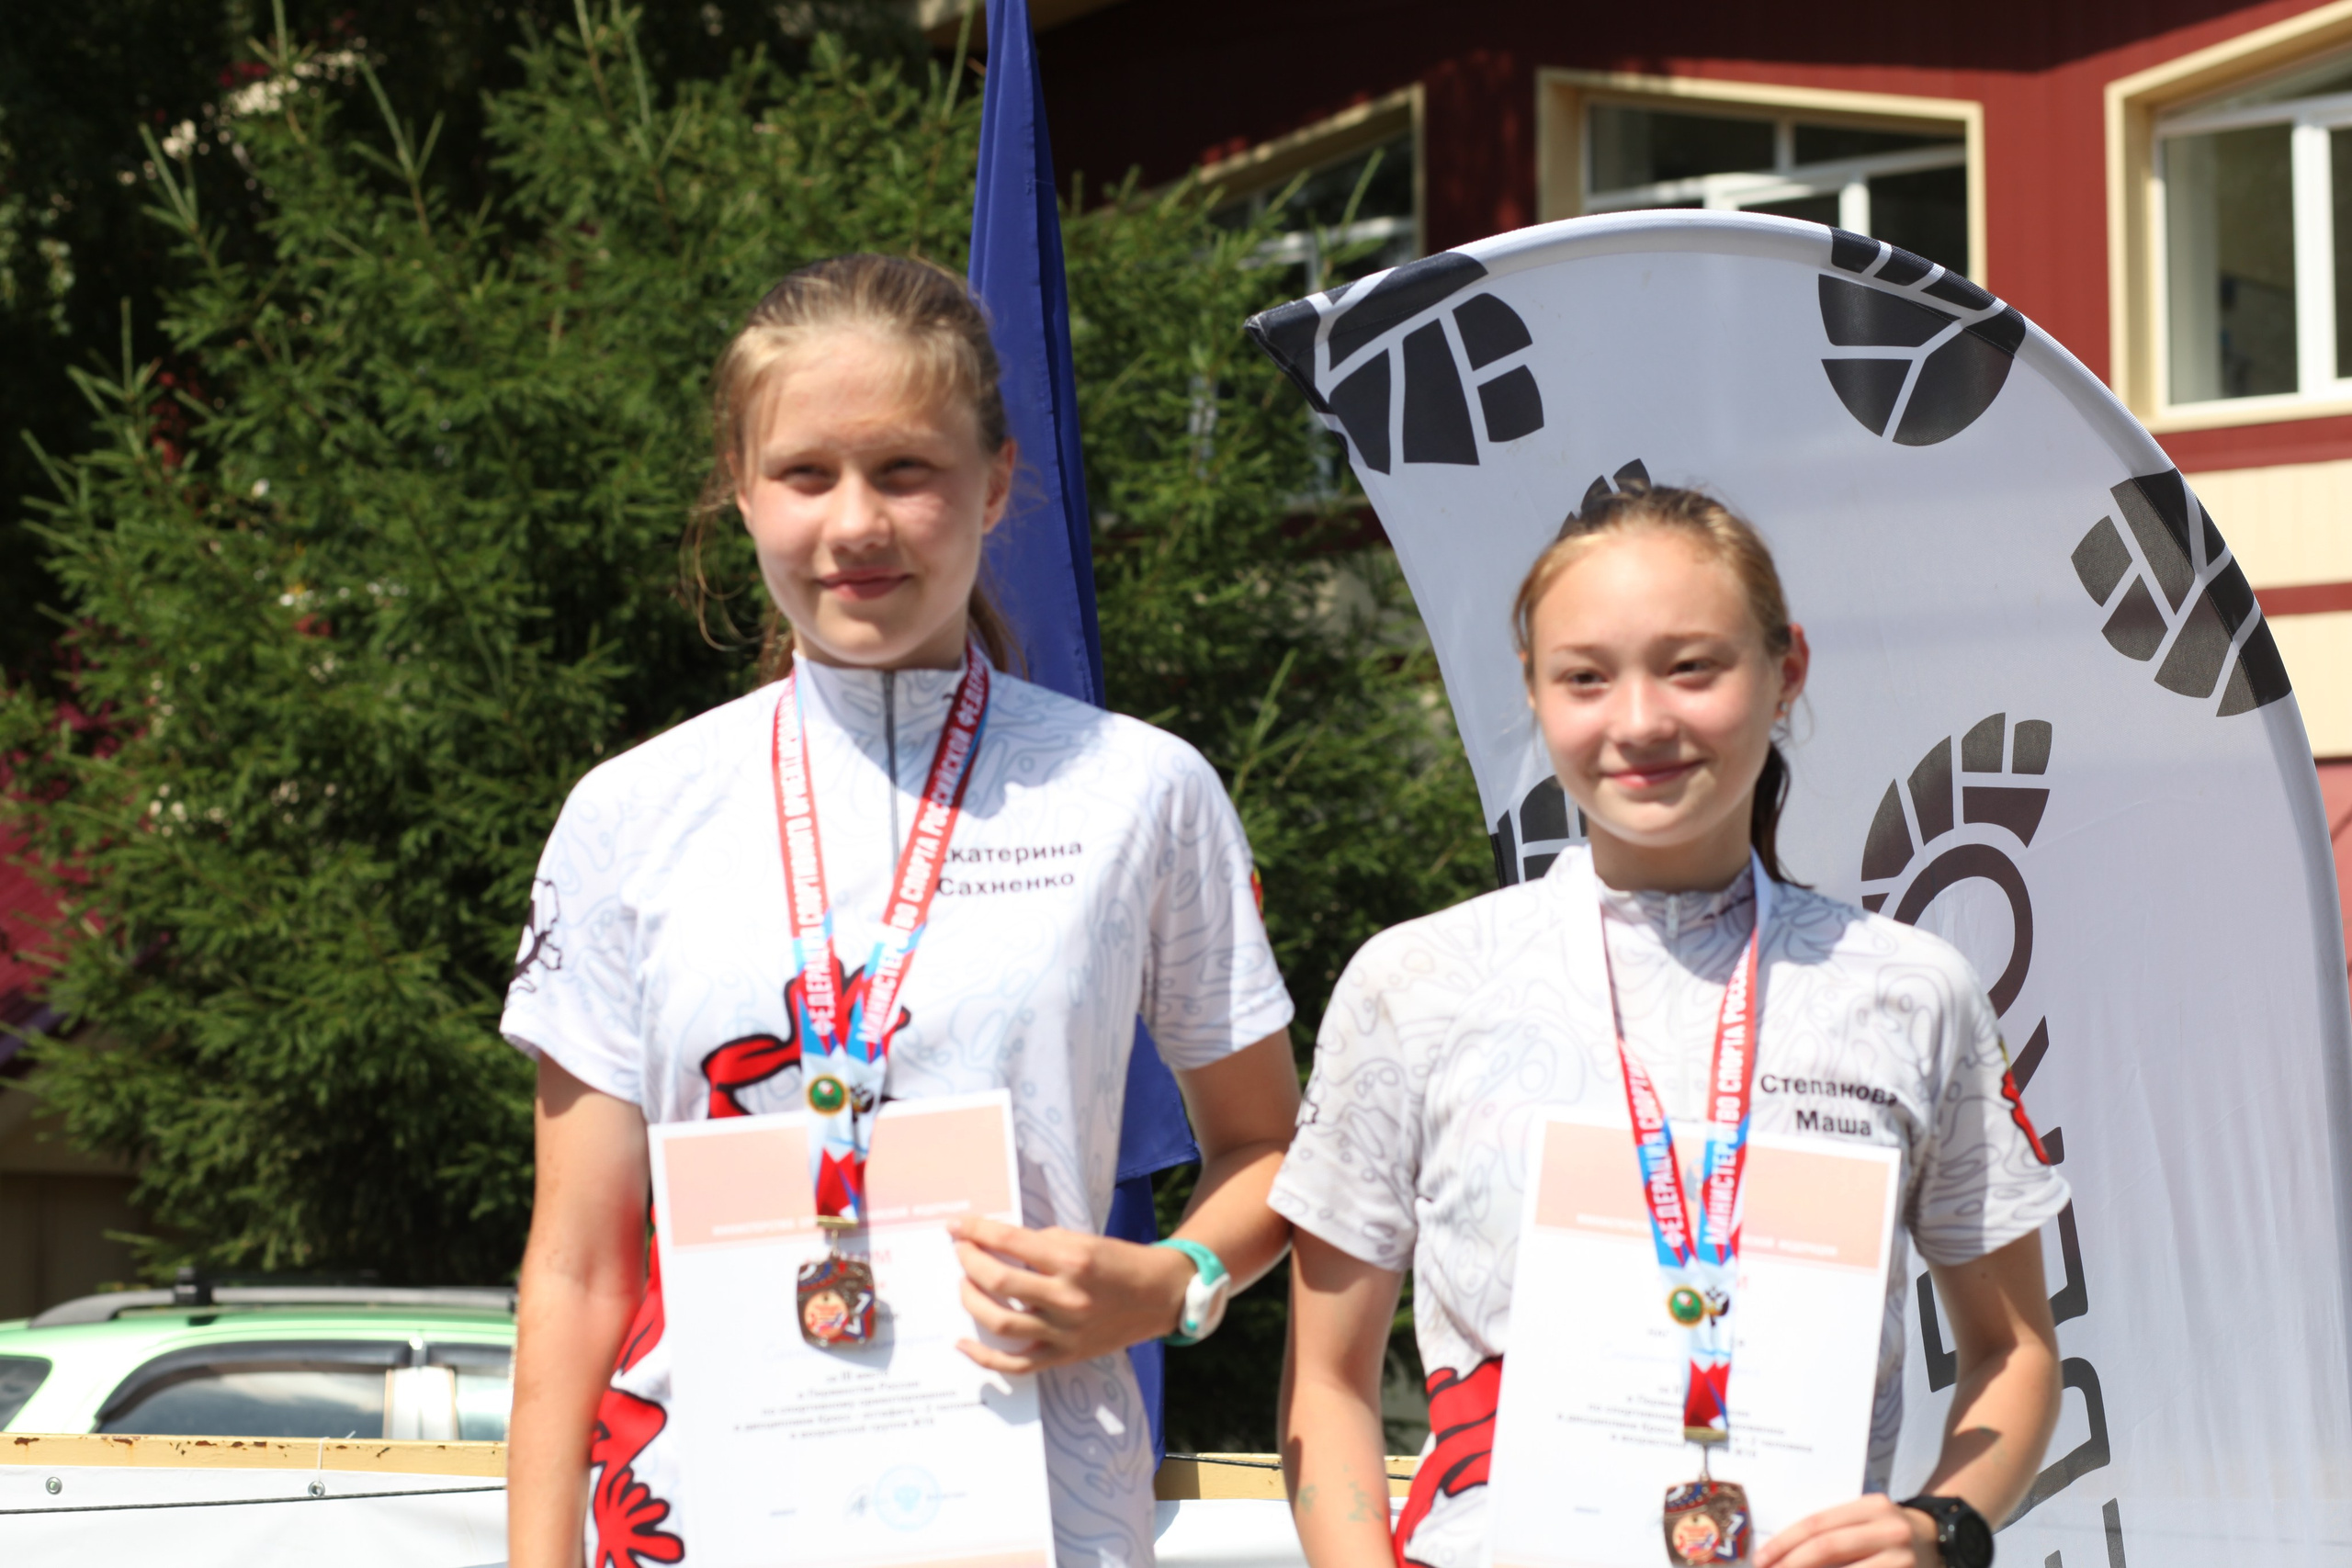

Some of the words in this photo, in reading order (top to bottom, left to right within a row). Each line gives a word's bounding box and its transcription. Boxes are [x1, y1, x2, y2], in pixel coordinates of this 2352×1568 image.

[899, 837, 941, 903] СПОРТА
[938, 874, 1075, 897] Сахненко
[944, 841, 1082, 864] катерина
[1717, 1026, 1746, 1093] СПОРТА
[1796, 1110, 1871, 1136] Маша
[1640, 1131, 1685, 1247] ФЕДЕРАЦИЯ
[1702, 1097, 1742, 1246] МИНИСТЕРСТВО
